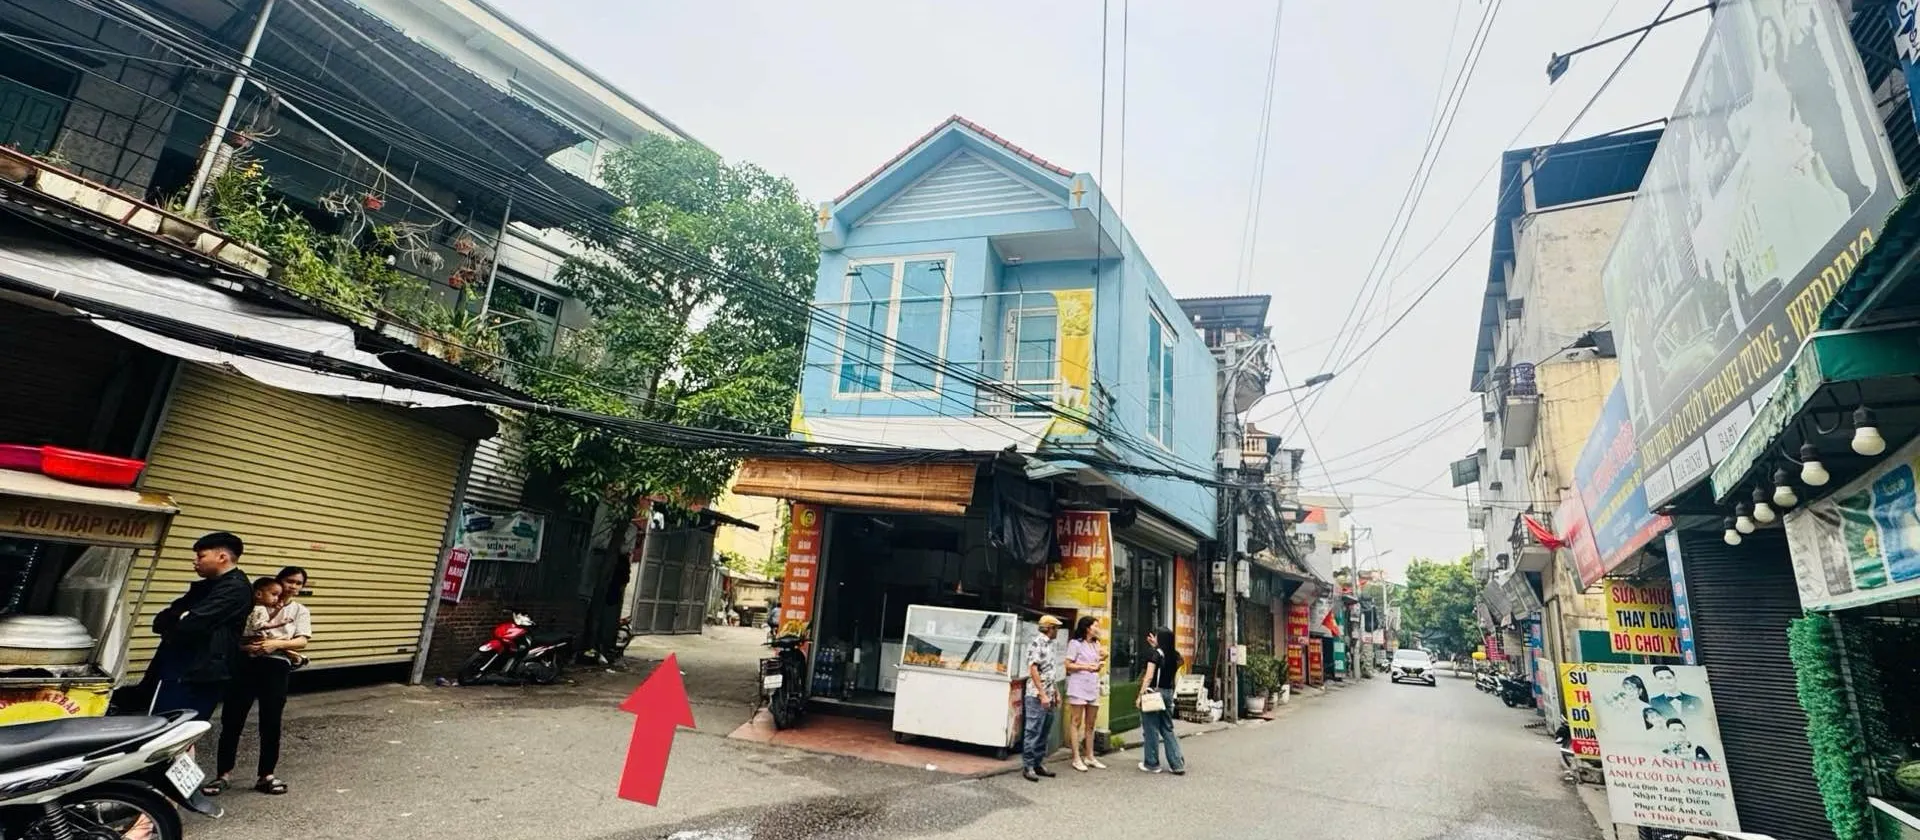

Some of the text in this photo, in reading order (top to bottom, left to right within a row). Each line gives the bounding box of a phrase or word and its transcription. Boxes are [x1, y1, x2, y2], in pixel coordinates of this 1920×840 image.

[1702, 357, 1745, 418] THANH
[1740, 322, 1783, 386] TÙNG
[14, 505, 49, 528] XÔI
[1074, 515, 1102, 537] RÁN
[1616, 610, 1646, 628] THAY
[1635, 633, 1666, 653] CHƠI
[1574, 690, 1592, 703] TH
[1581, 746, 1600, 755] 097
[1606, 754, 1646, 767] CHỤP
[1635, 770, 1663, 782] CƯỚI
[1686, 775, 1726, 789] NGOẠI
[1633, 791, 1656, 802] Nhận
[1659, 793, 1684, 804] Trang
[1633, 810, 1646, 819] In
[1651, 811, 1686, 825] Thiệp
